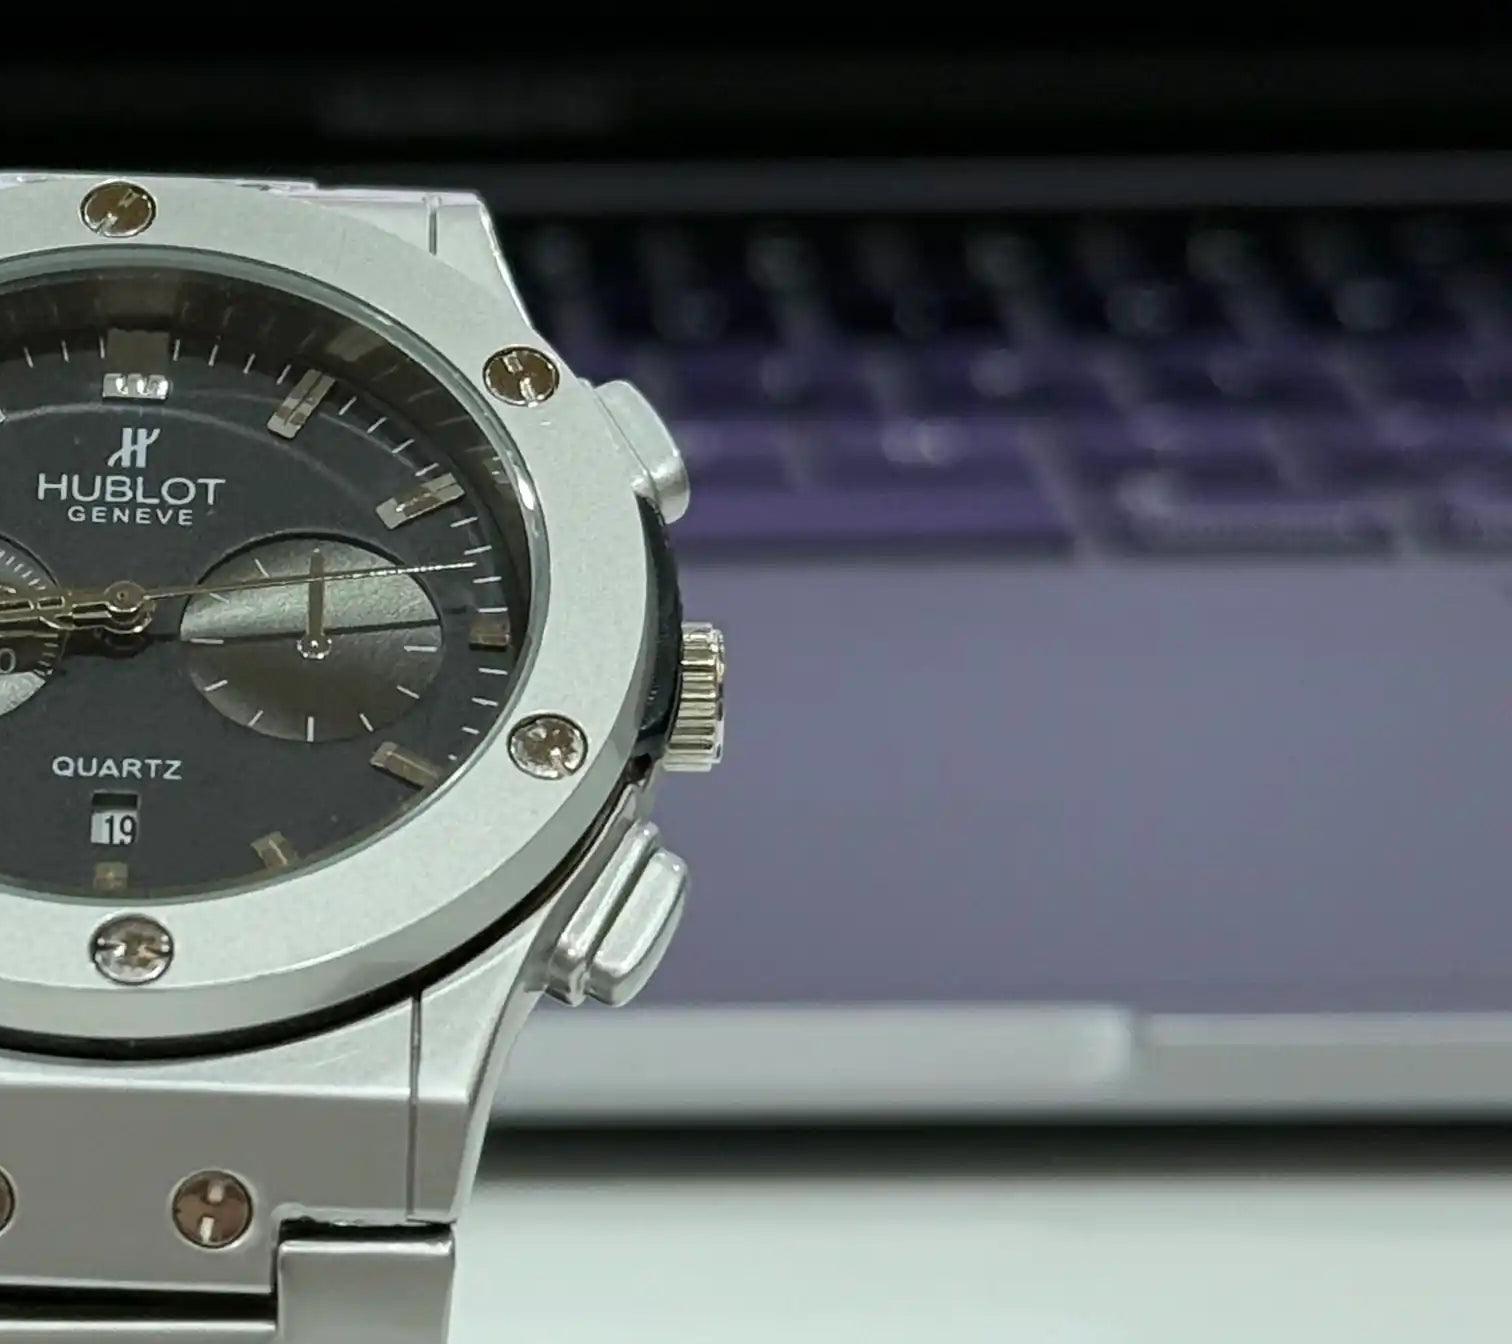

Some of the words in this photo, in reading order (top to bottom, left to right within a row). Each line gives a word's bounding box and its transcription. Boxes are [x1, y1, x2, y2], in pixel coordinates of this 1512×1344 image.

[37, 472, 227, 506] HUBLOT
[67, 505, 193, 526] GENEVE
[51, 755, 183, 780] QUARTZ
[104, 814, 137, 845] 19
